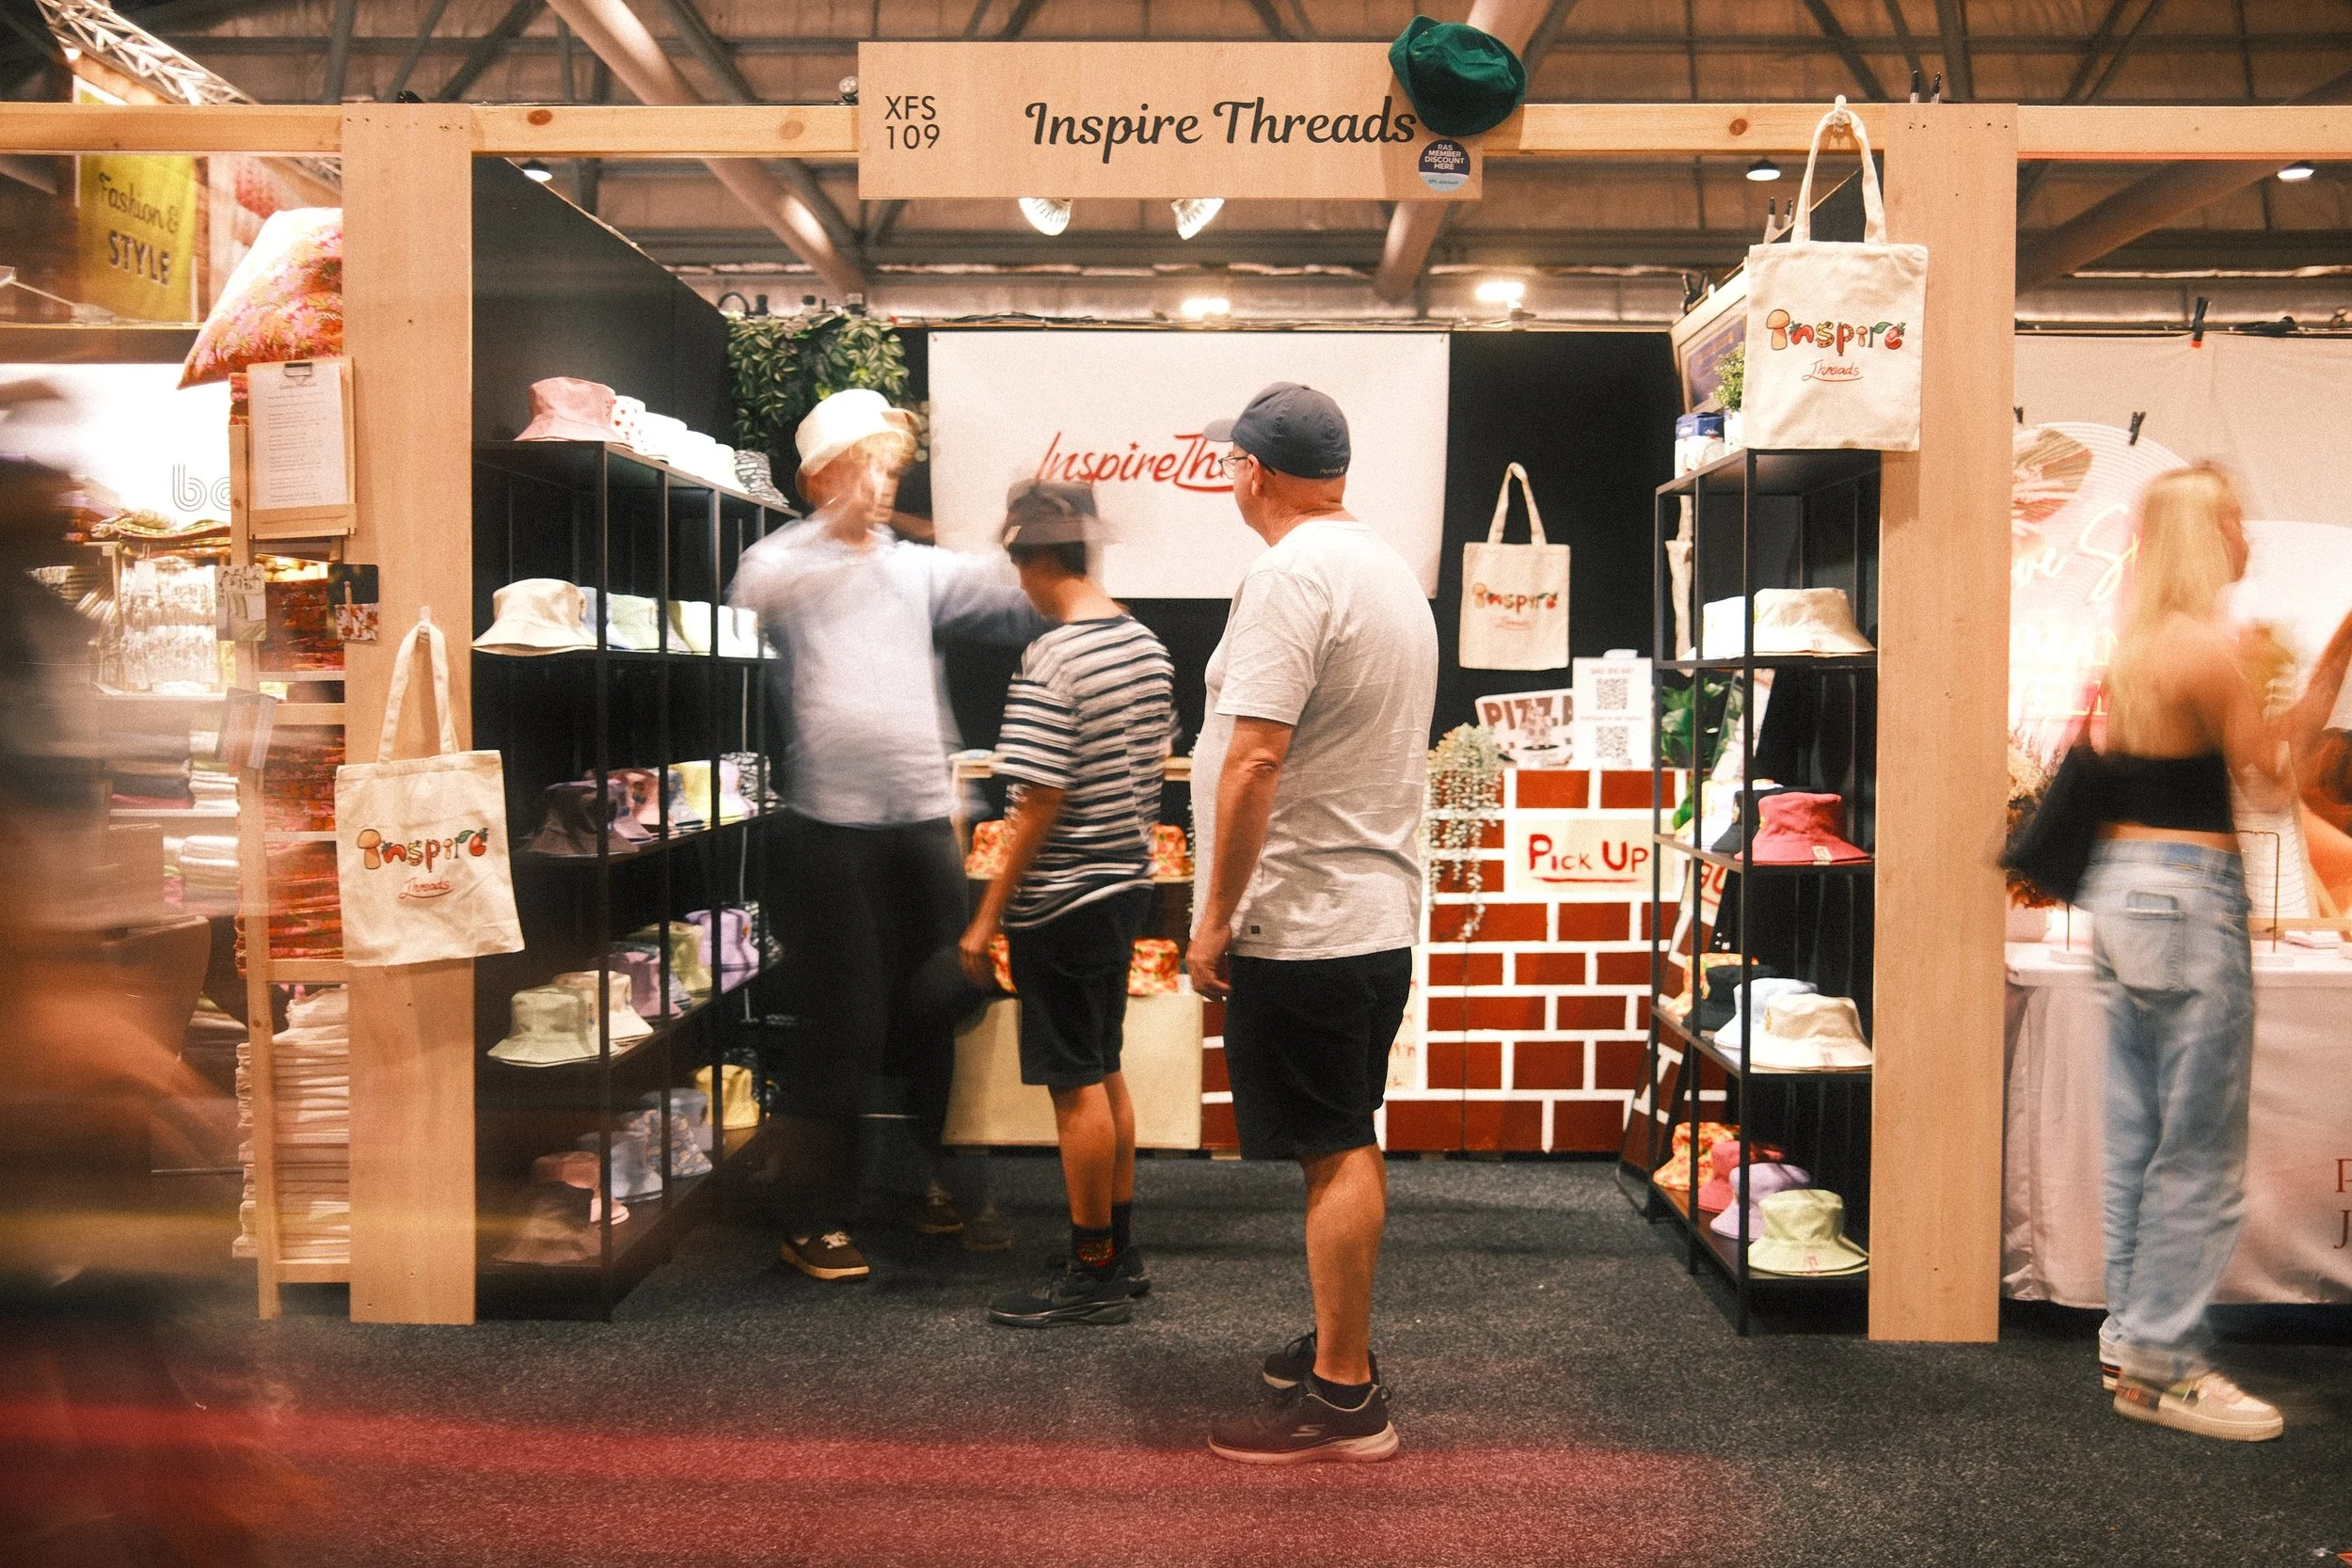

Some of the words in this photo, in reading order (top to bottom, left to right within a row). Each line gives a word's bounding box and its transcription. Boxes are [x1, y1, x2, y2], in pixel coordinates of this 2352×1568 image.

[884, 95, 937, 120] XFS
[1025, 102, 1203, 164] Inspire
[1213, 95, 1417, 143] Threads
[886, 123, 940, 150] 109
[98, 171, 164, 230] Fashion
[108, 230, 171, 287] STYLE
[1802, 359, 1864, 382] Threads
[1037, 431, 1234, 493] InspireTh
